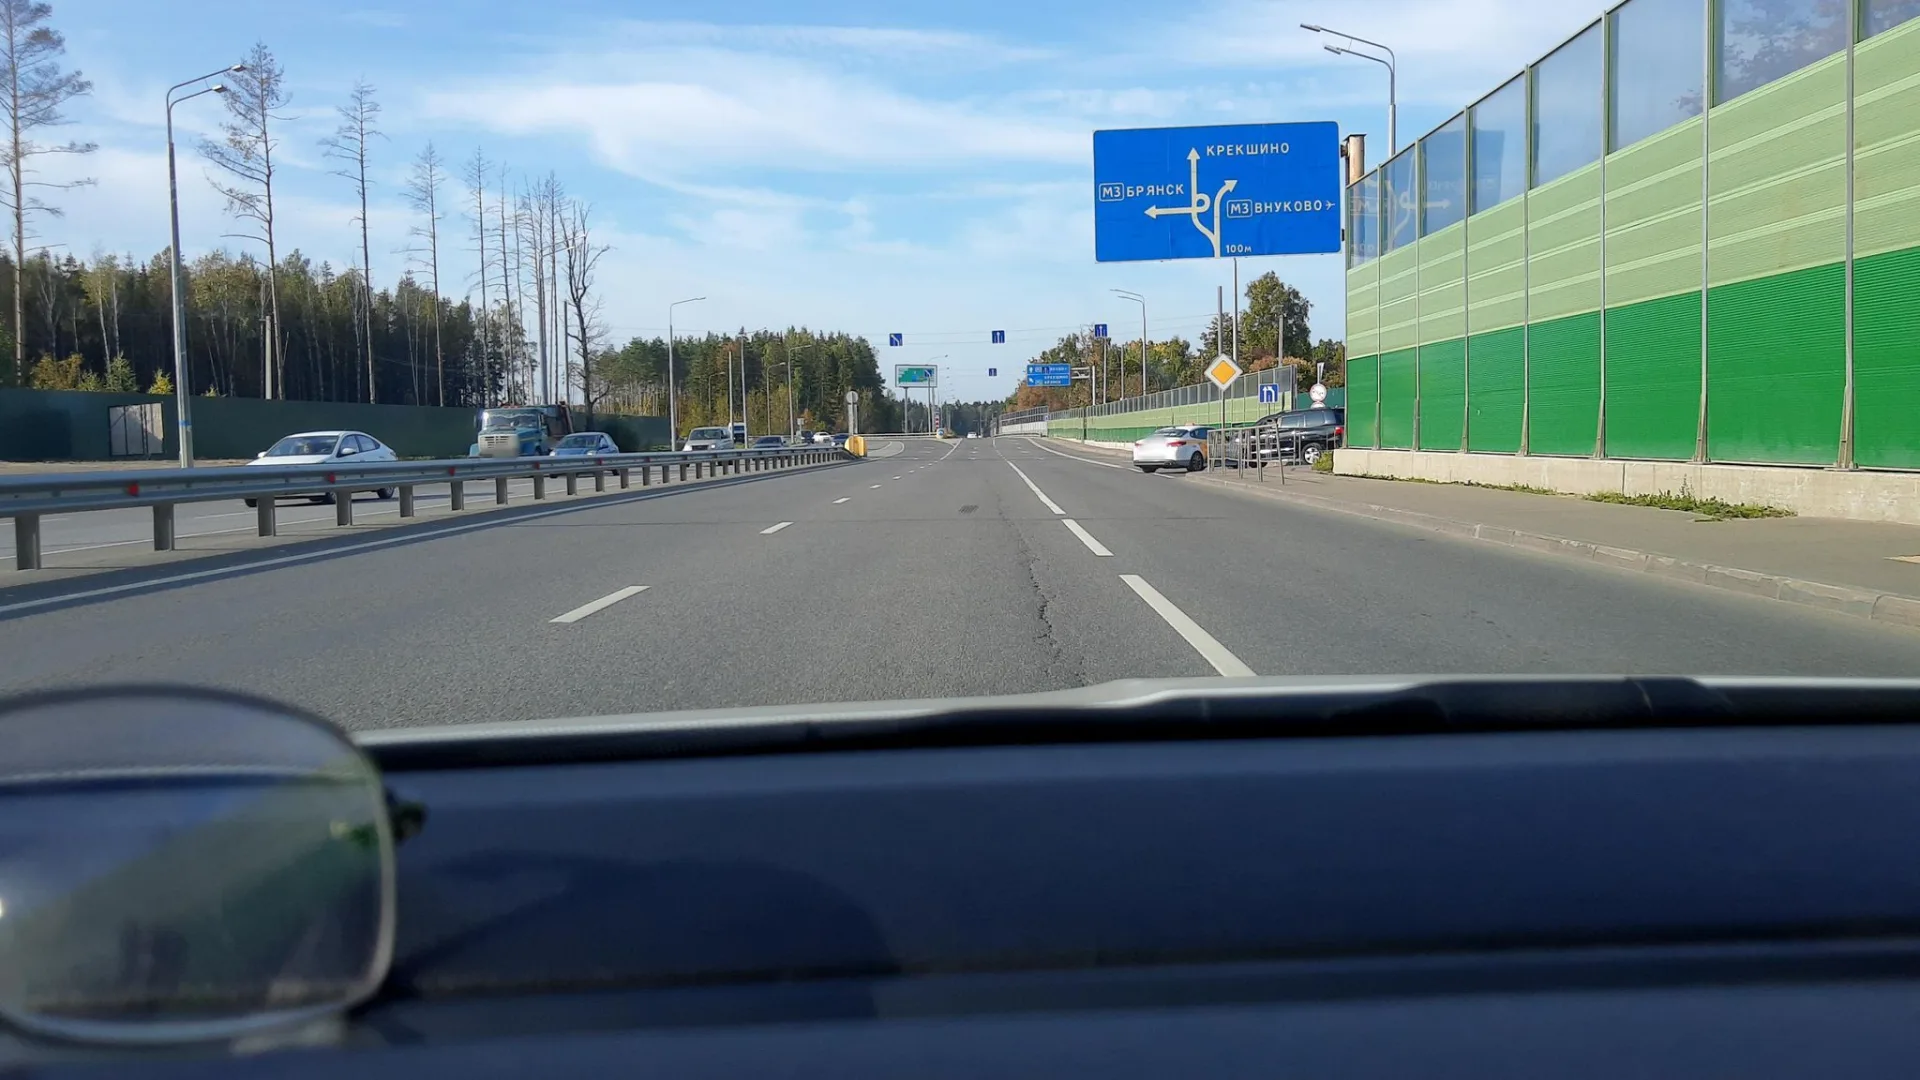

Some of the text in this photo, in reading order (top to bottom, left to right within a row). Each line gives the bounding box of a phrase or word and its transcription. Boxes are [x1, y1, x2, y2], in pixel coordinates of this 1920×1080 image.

[1206, 142, 1290, 156] КРЕКШИНО
[1126, 183, 1185, 198] БРЯНСК
[1255, 199, 1322, 214] ВНУКОВО
